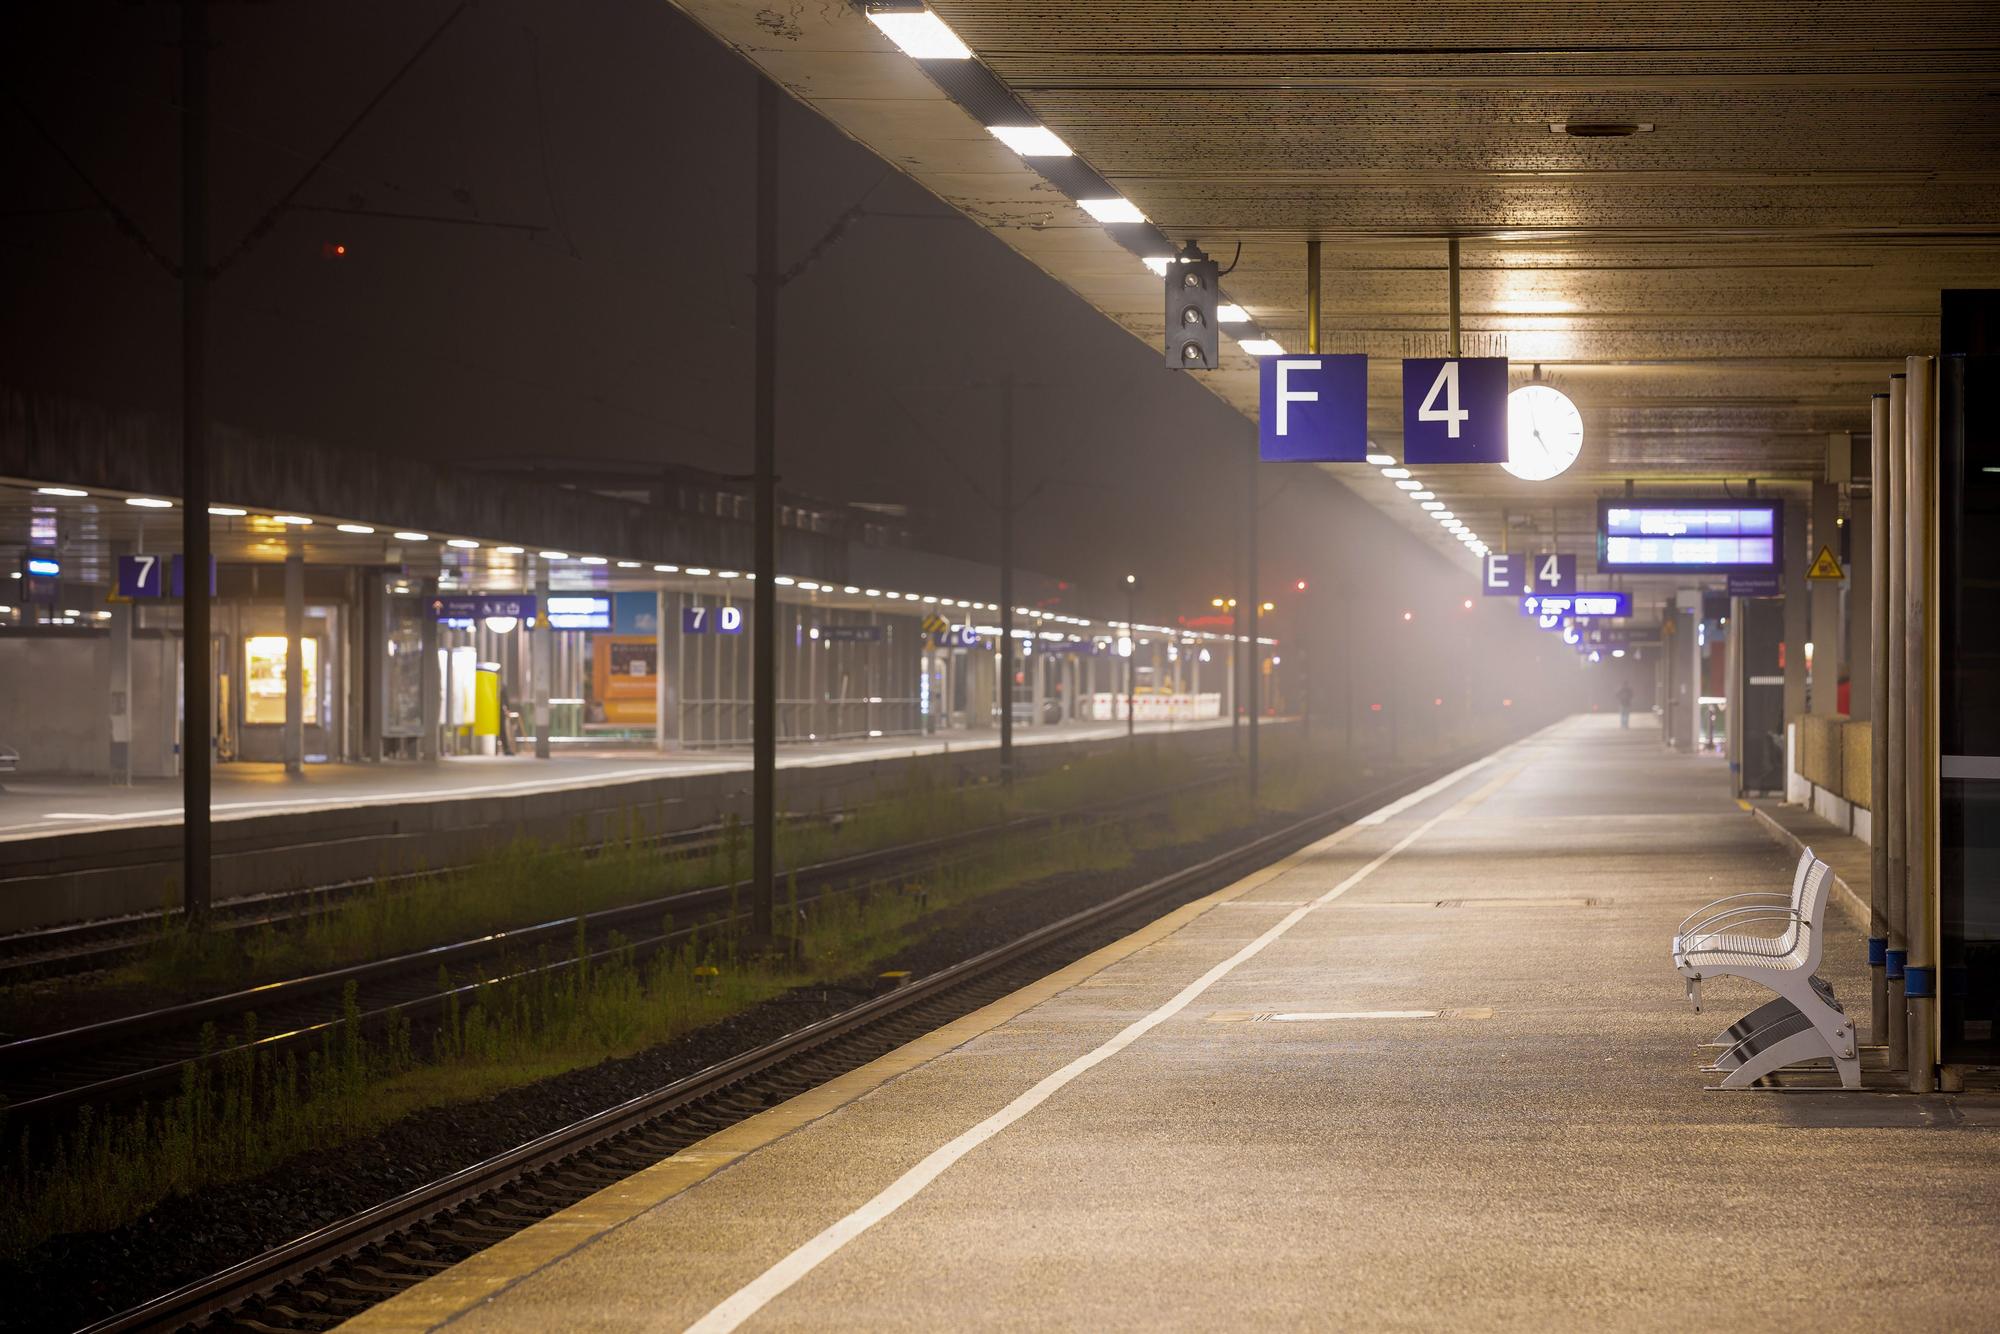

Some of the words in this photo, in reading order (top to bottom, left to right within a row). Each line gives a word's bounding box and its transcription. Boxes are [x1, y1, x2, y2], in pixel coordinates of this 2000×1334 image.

[1276, 360, 1322, 435] F
[1418, 361, 1469, 439] 4
[134, 556, 155, 588] 7
[1487, 554, 1509, 588] E
[1539, 554, 1561, 587] 4
[691, 607, 705, 629] 7
[721, 607, 741, 631] D
[962, 626, 976, 645] C
